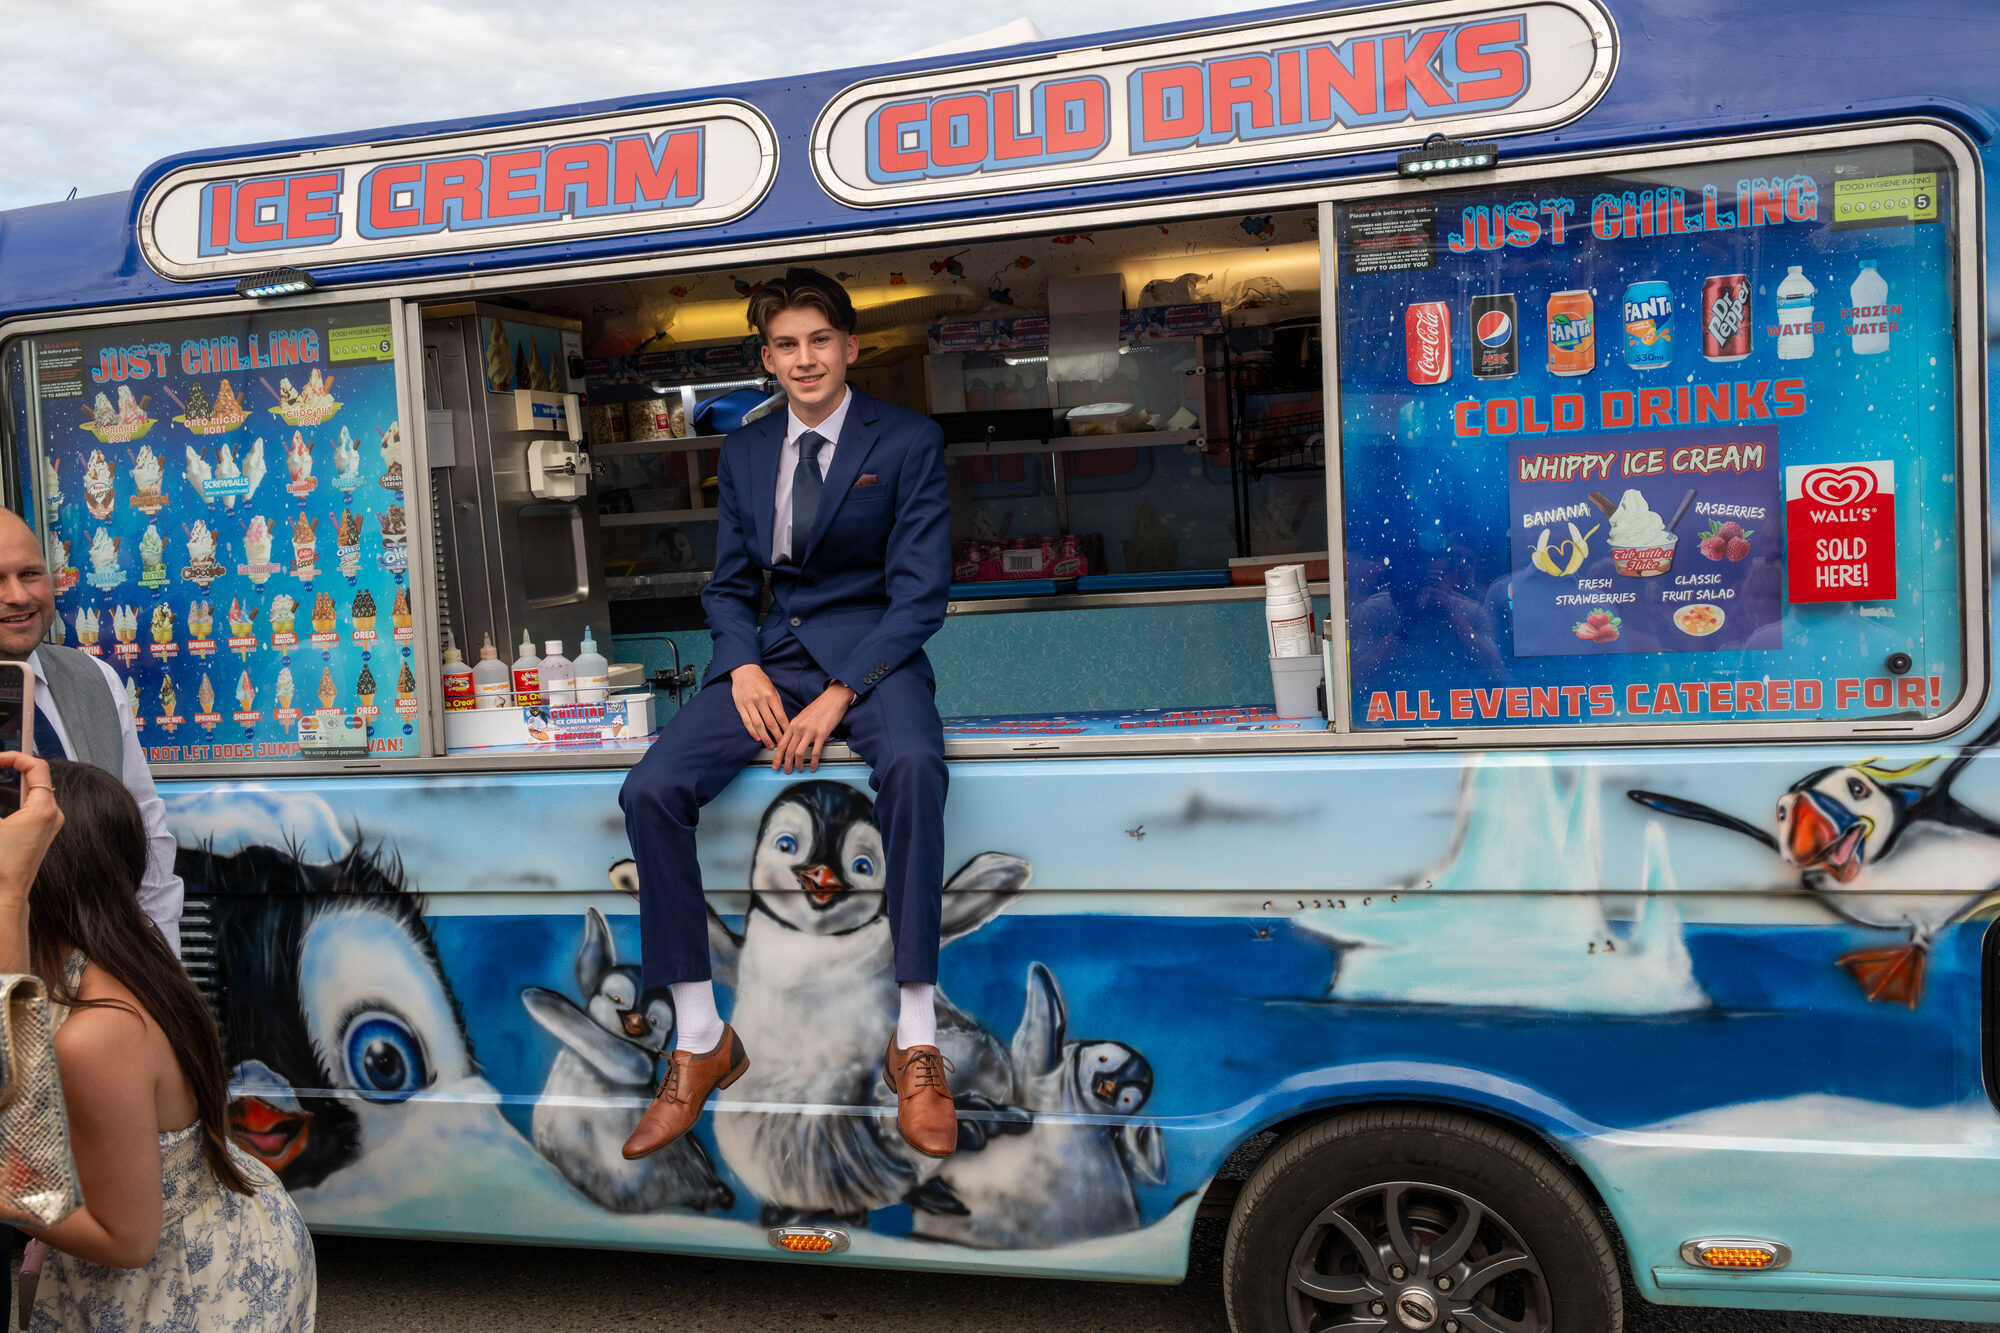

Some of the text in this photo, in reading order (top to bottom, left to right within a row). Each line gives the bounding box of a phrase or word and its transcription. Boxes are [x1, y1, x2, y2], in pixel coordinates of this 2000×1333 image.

[865, 13, 1528, 184] COLD DRINKS
[1840, 176, 1931, 191] FOOD HYGIENE RATING
[198, 126, 705, 258] ICE CREAM
[1917, 195, 1926, 208] 5
[1448, 174, 1819, 253] JUST CHILLING
[1388, 262, 1411, 270] ASSIST
[1624, 296, 1672, 322] FANTA
[1712, 292, 1734, 321] Dr
[1841, 304, 1901, 319] FROZEN
[1708, 281, 1749, 347] Pepper
[1549, 320, 1591, 342] FANTA
[1767, 322, 1825, 337] WATER
[1845, 321, 1899, 336] WATER
[382, 341, 389, 351] 5
[91, 328, 320, 384] JUST CHILLING
[286, 406, 333, 418] CHOC NUT
[1454, 377, 1806, 438] COLD DRINKS
[184, 414, 245, 428] OREO BISCOFF
[297, 416, 321, 427] BOAT
[100, 424, 138, 436] SPRINKLE
[203, 425, 227, 435] BOAT
[108, 433, 132, 443] BOAT
[1519, 442, 1767, 483] WHIPPY ICE CREAM
[204, 477, 249, 489] SCREWBALLS
[1523, 502, 1592, 529] BANANA
[1694, 501, 1767, 519] RASBERRIES
[336, 546, 361, 557] OREO
[1614, 550, 1635, 560] Tub
[1638, 548, 1662, 560] with
[1816, 537, 1867, 561] SOLD
[1674, 574, 1722, 586] CLASSIC
[1816, 563, 1868, 588] HERE!
[1578, 579, 1613, 590] FRESH
[1555, 592, 1637, 606] STRAWBERRIES
[1662, 588, 1736, 602] FRUIT SALAD
[311, 633, 337, 641] BISCOFF
[353, 630, 376, 639] OREO
[115, 643, 138, 654] TWIN
[188, 641, 215, 649] SPRINKLE
[229, 638, 256, 646] SHERBET
[1366, 675, 1942, 722] ALL EVENTS CATERED FOR!
[233, 712, 260, 720] SHERBET
[315, 708, 341, 717] BISCOFF
[356, 706, 378, 715] OREO
[550, 706, 605, 719] CHILLING
[150, 738, 404, 760] NOT LET DOGS JUMP VAN!
[340, 749, 365, 758] payments.
